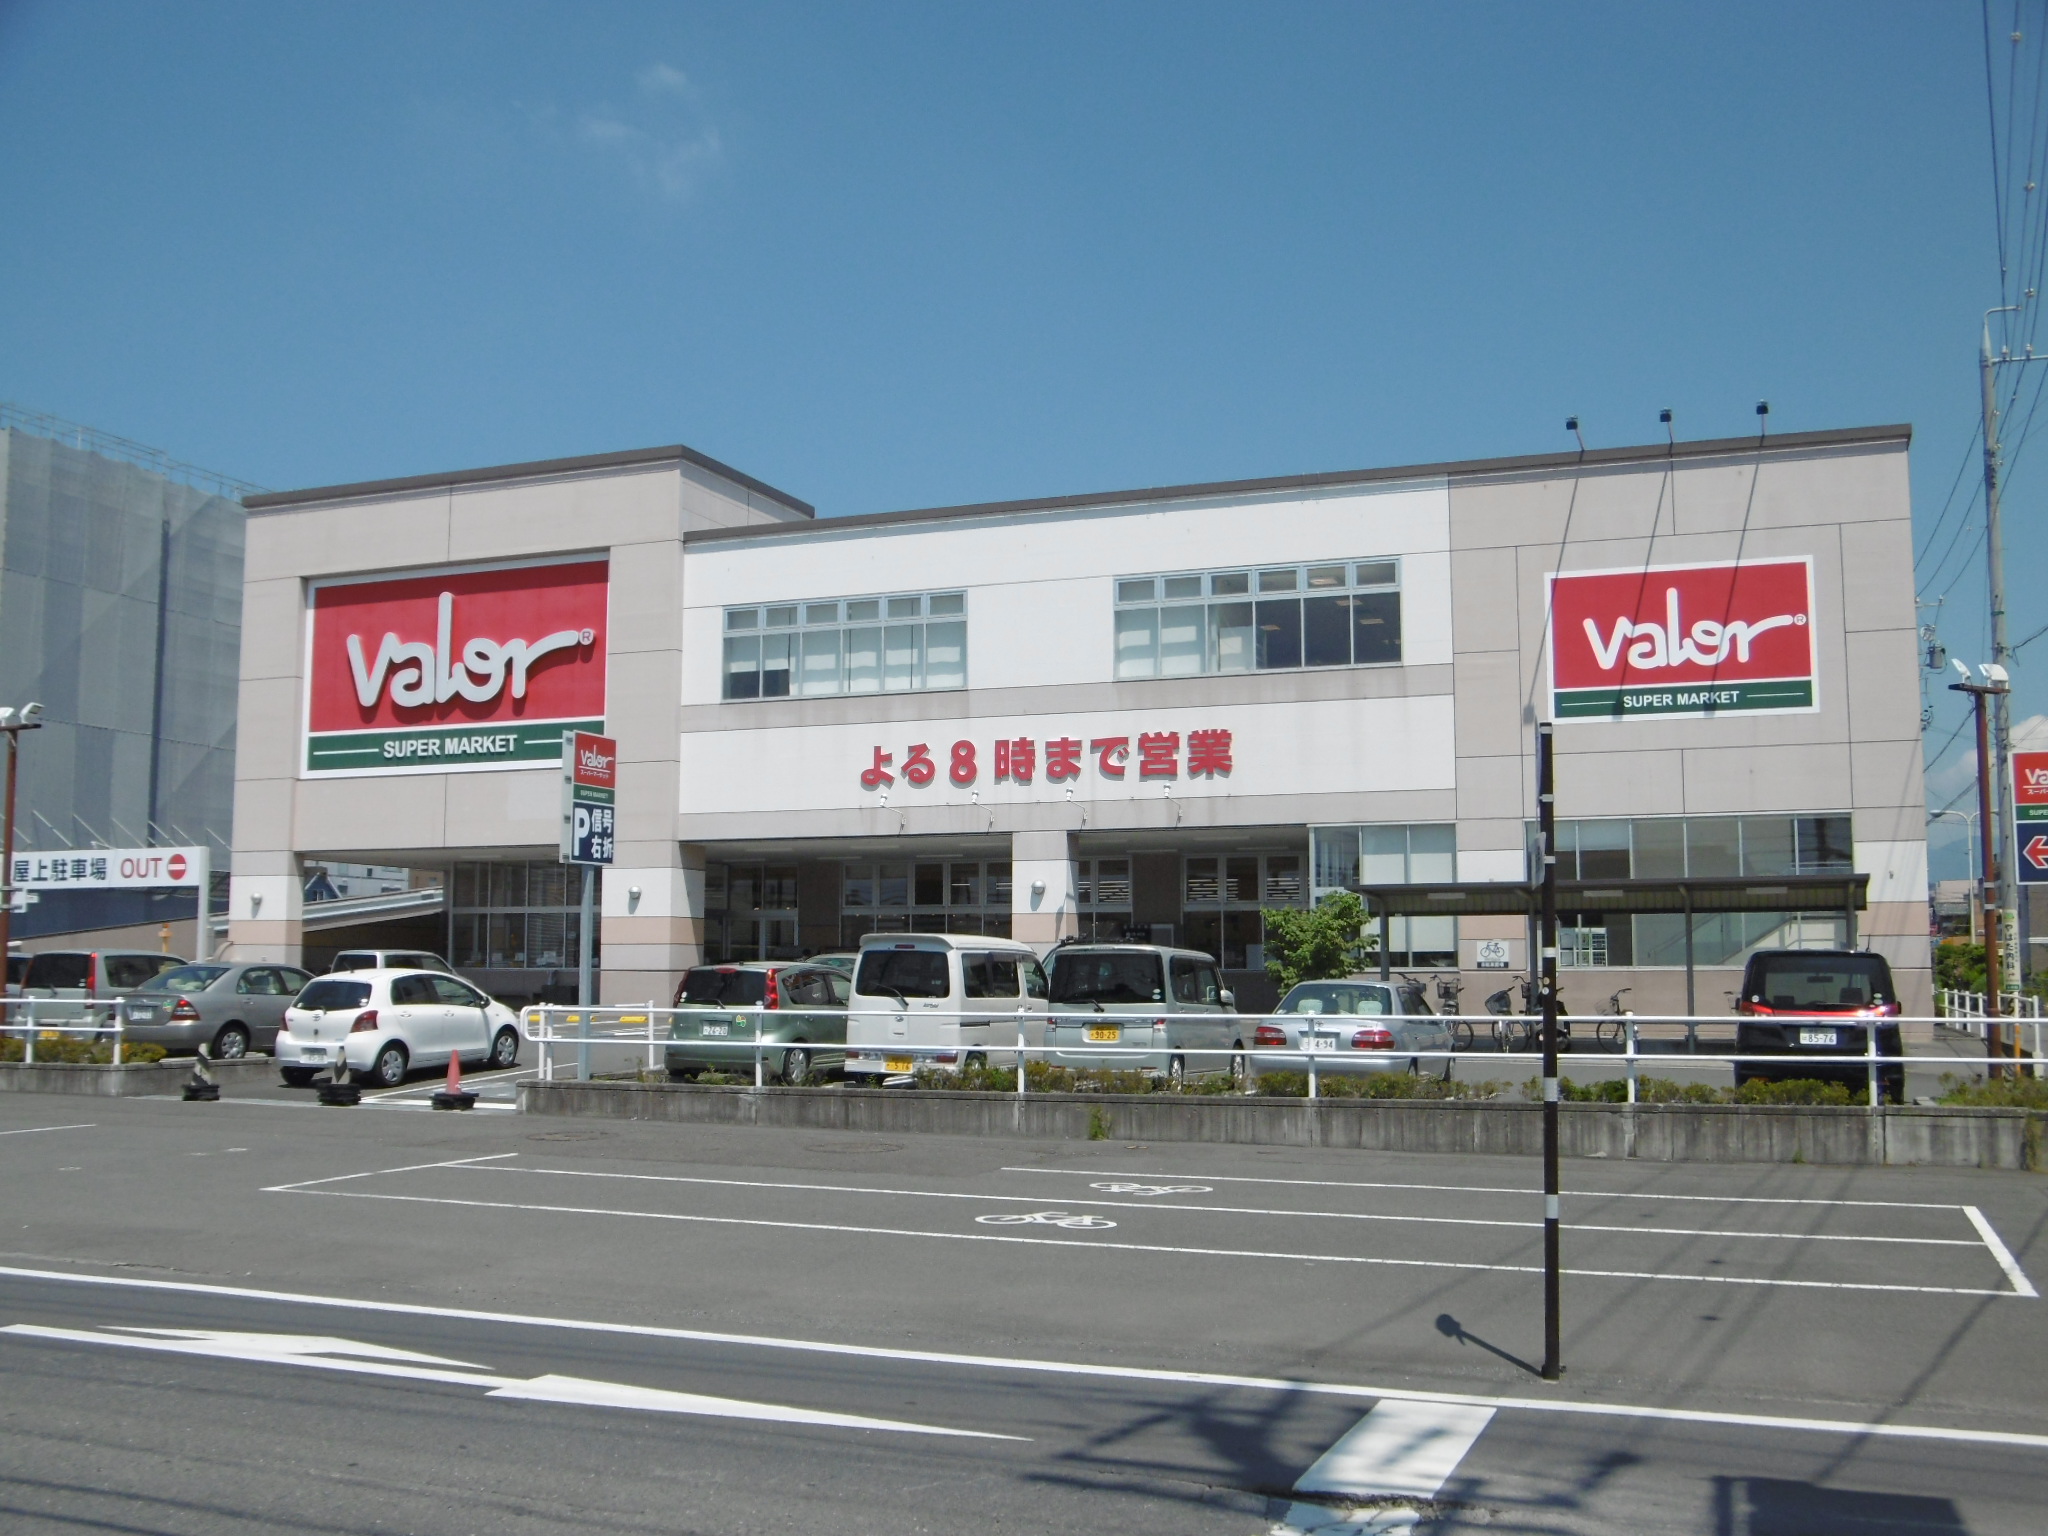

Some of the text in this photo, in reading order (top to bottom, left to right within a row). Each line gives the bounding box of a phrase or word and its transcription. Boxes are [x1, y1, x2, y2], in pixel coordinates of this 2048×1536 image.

[1623, 691, 1740, 708] SUPER MARKET
[383, 735, 518, 758] SUPER MARKET
[860, 728, 1232, 784] よる8時まで営業
[573, 807, 591, 857] P
[591, 808, 613, 834] 信号
[591, 834, 614, 859] 右折
[13, 857, 107, 882] 屋上駐車場
[120, 857, 163, 879] OUT
